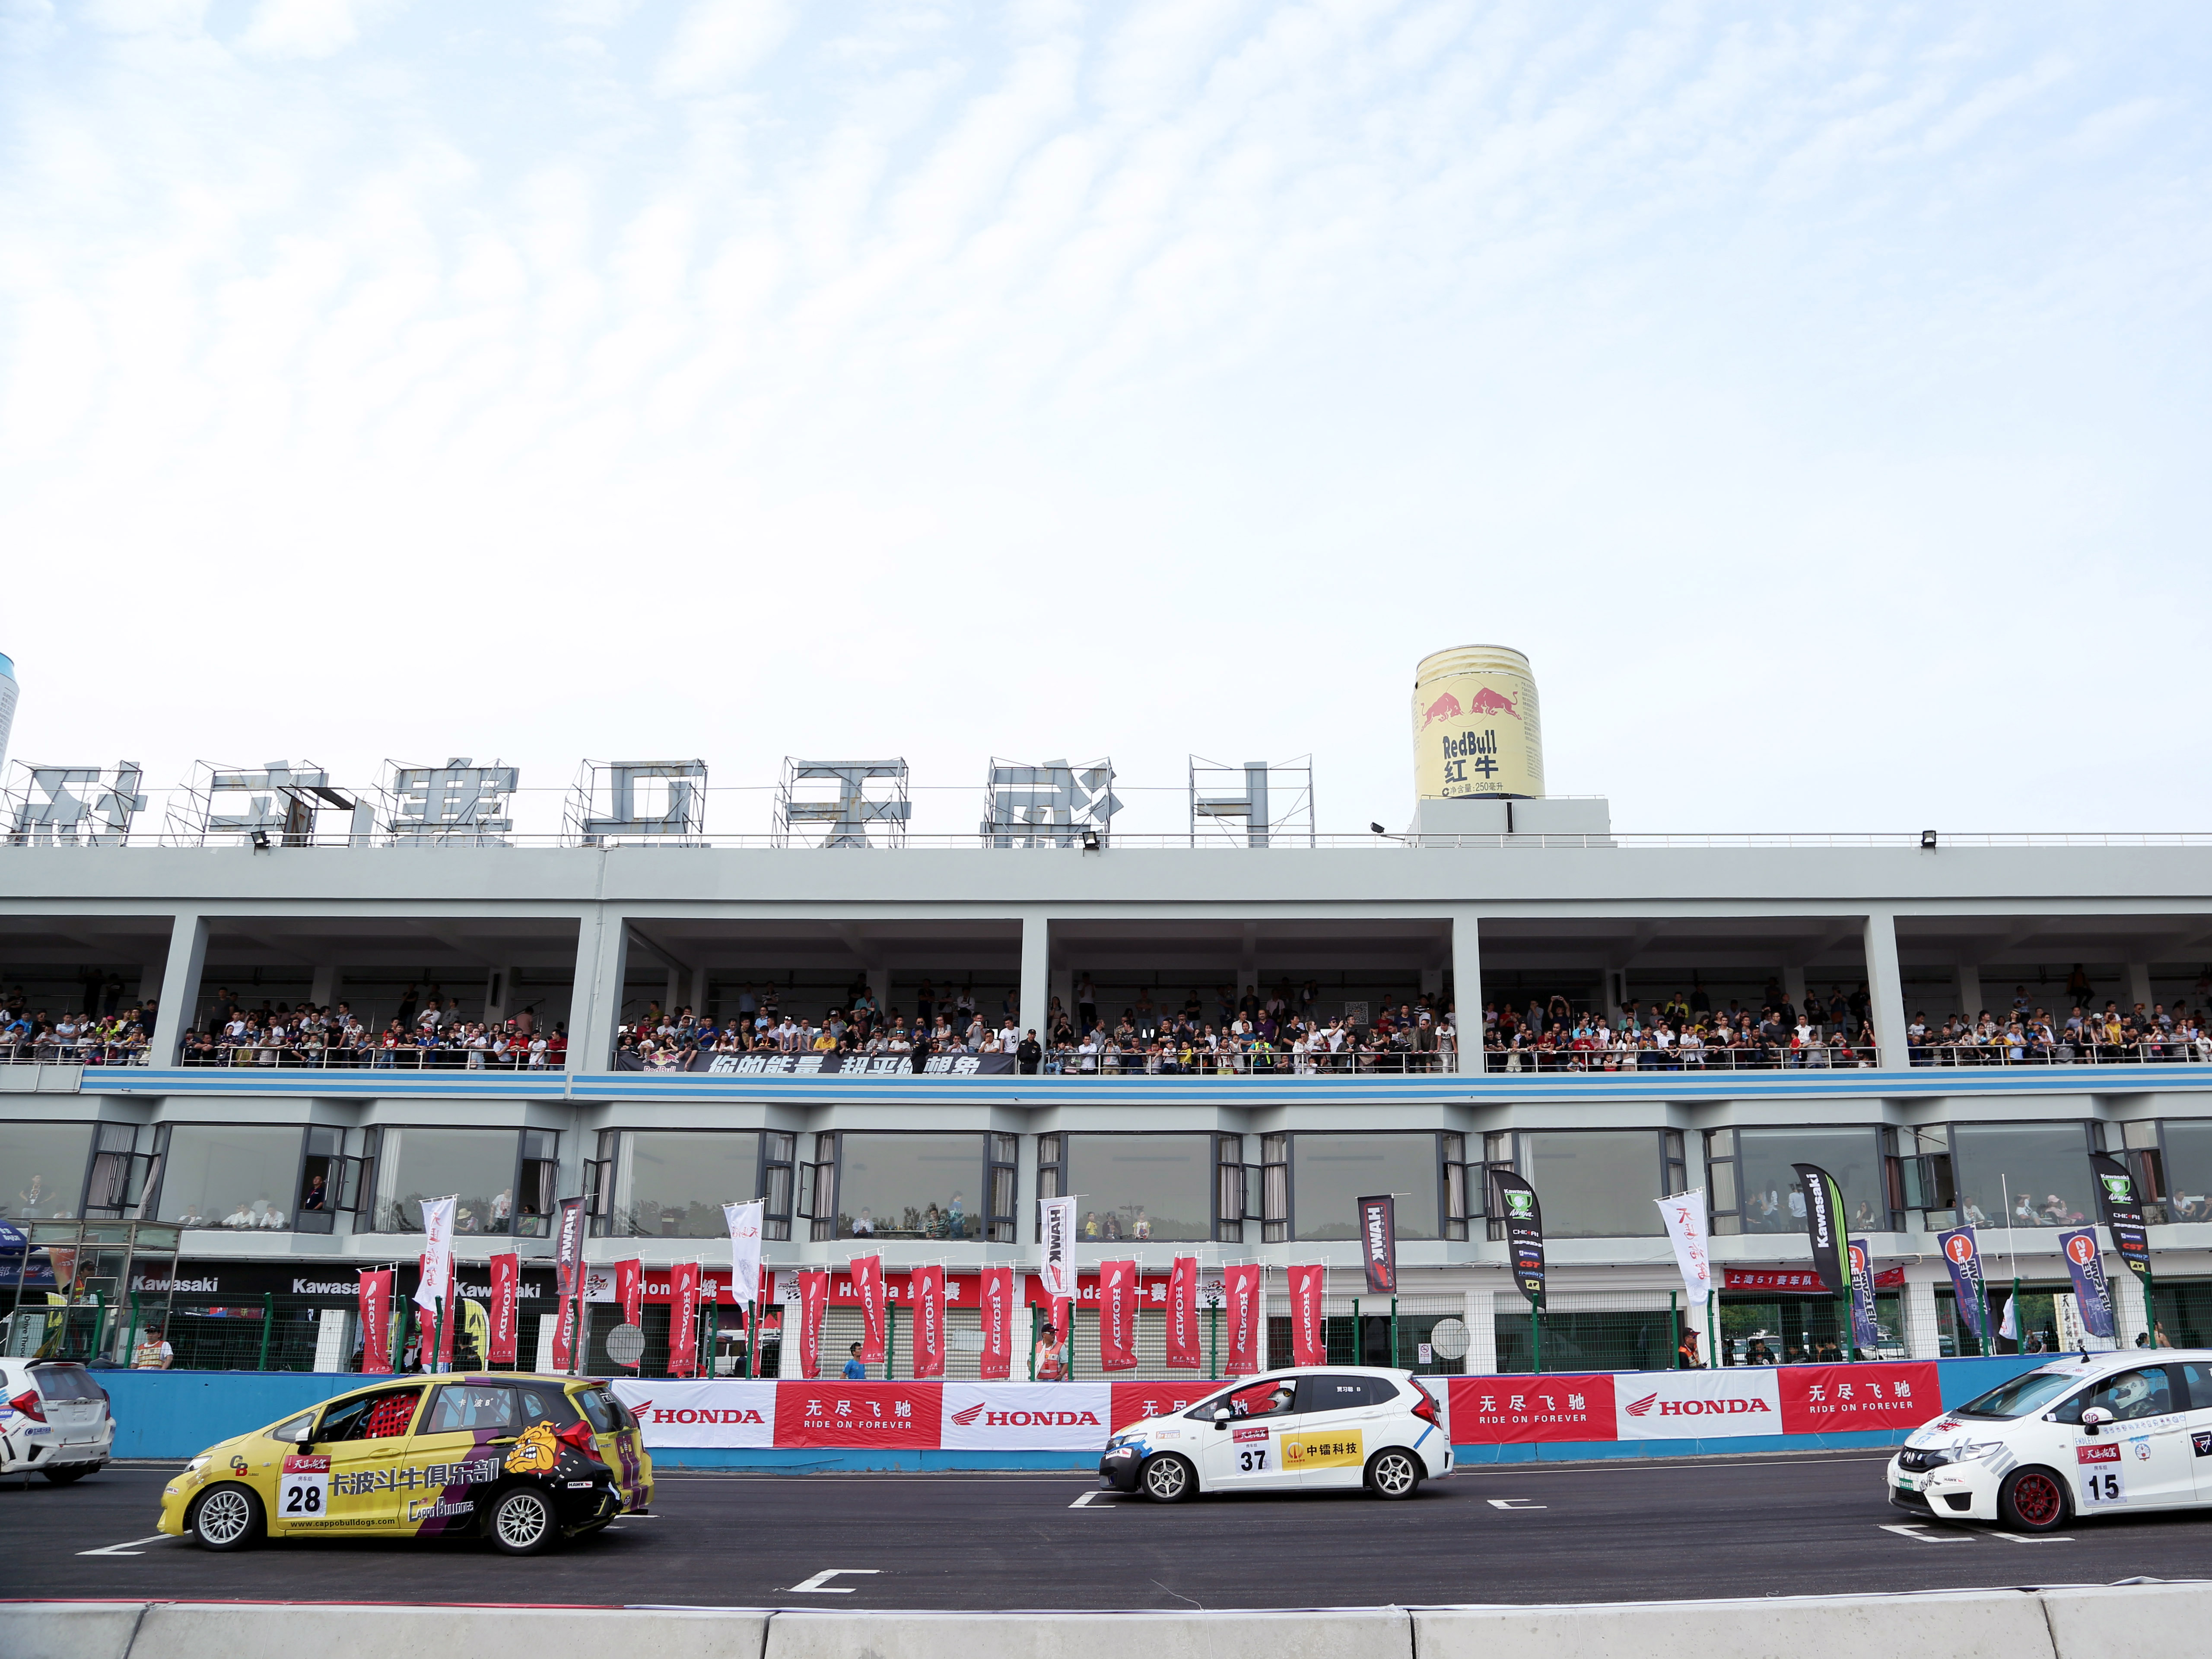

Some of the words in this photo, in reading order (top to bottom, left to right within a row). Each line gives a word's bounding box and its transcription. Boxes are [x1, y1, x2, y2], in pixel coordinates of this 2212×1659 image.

[1443, 729, 1497, 760] RedBull
[1444, 756, 1499, 784] 红牛
[1806, 1173, 1830, 1248] Kawasaki
[2122, 1243, 2144, 1251] CST
[132, 1275, 218, 1292] Kawasaki
[293, 1278, 361, 1295] Kawasa
[1730, 1274, 1812, 1285] 上海51赛车队
[455, 1281, 541, 1298] Kawaki
[1809, 1380, 1912, 1402] 无尽飞驰
[805, 1399, 912, 1417] 无尽飞驰
[1479, 1393, 1586, 1413] 无尽飞驰
[1659, 1398, 1771, 1416] HONDA
[1810, 1405, 1835, 1414] RIDE
[1841, 1404, 1856, 1412] ON
[1862, 1401, 1913, 1411] FOREVER
[652, 1409, 765, 1424] HONDA
[837, 1420, 852, 1428] ON
[859, 1420, 912, 1429] FOREVER
[985, 1411, 1101, 1426] HONDA
[1479, 1415, 1506, 1424] RIDE
[1512, 1415, 1528, 1424] ON
[1535, 1414, 1587, 1423] FOREVER
[2085, 1414, 2098, 1423] STP
[1307, 1442, 1357, 1456] 中镭科技
[1241, 1450, 1265, 1471] 37
[328, 1458, 499, 1496] 卡波斗牛俱乐部
[1899, 1480, 1913, 1489] TAKATA
[2088, 1474, 2119, 1500] 15
[286, 1486, 321, 1512] 28
[291, 1519, 395, 1527] www.cappobulldogs.com
